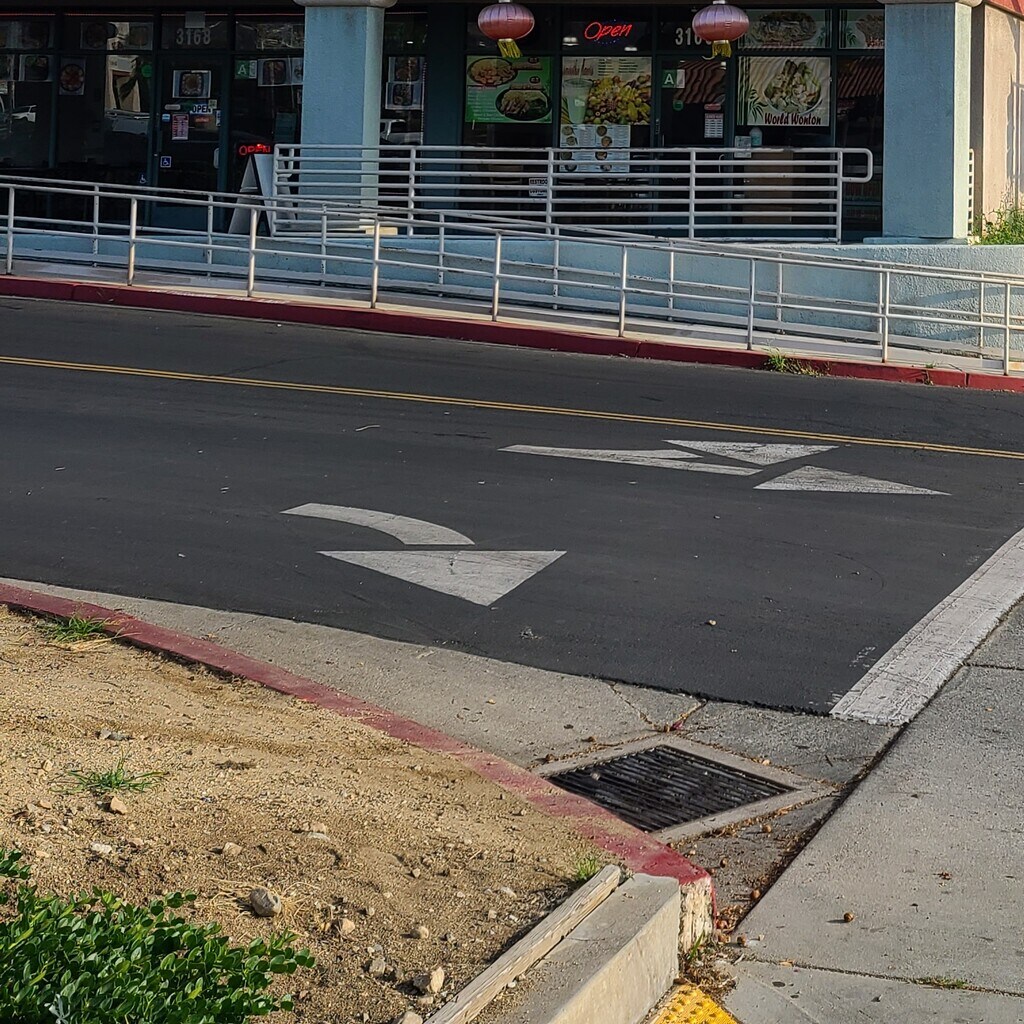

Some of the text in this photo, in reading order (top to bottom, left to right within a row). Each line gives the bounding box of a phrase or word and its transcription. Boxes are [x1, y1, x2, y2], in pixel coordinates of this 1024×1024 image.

[176, 28, 211, 45] 3168
[584, 21, 633, 41] Open
[238, 64, 247, 75] A
[664, 73, 675, 85] A
[764, 112, 822, 126] World Wonton
